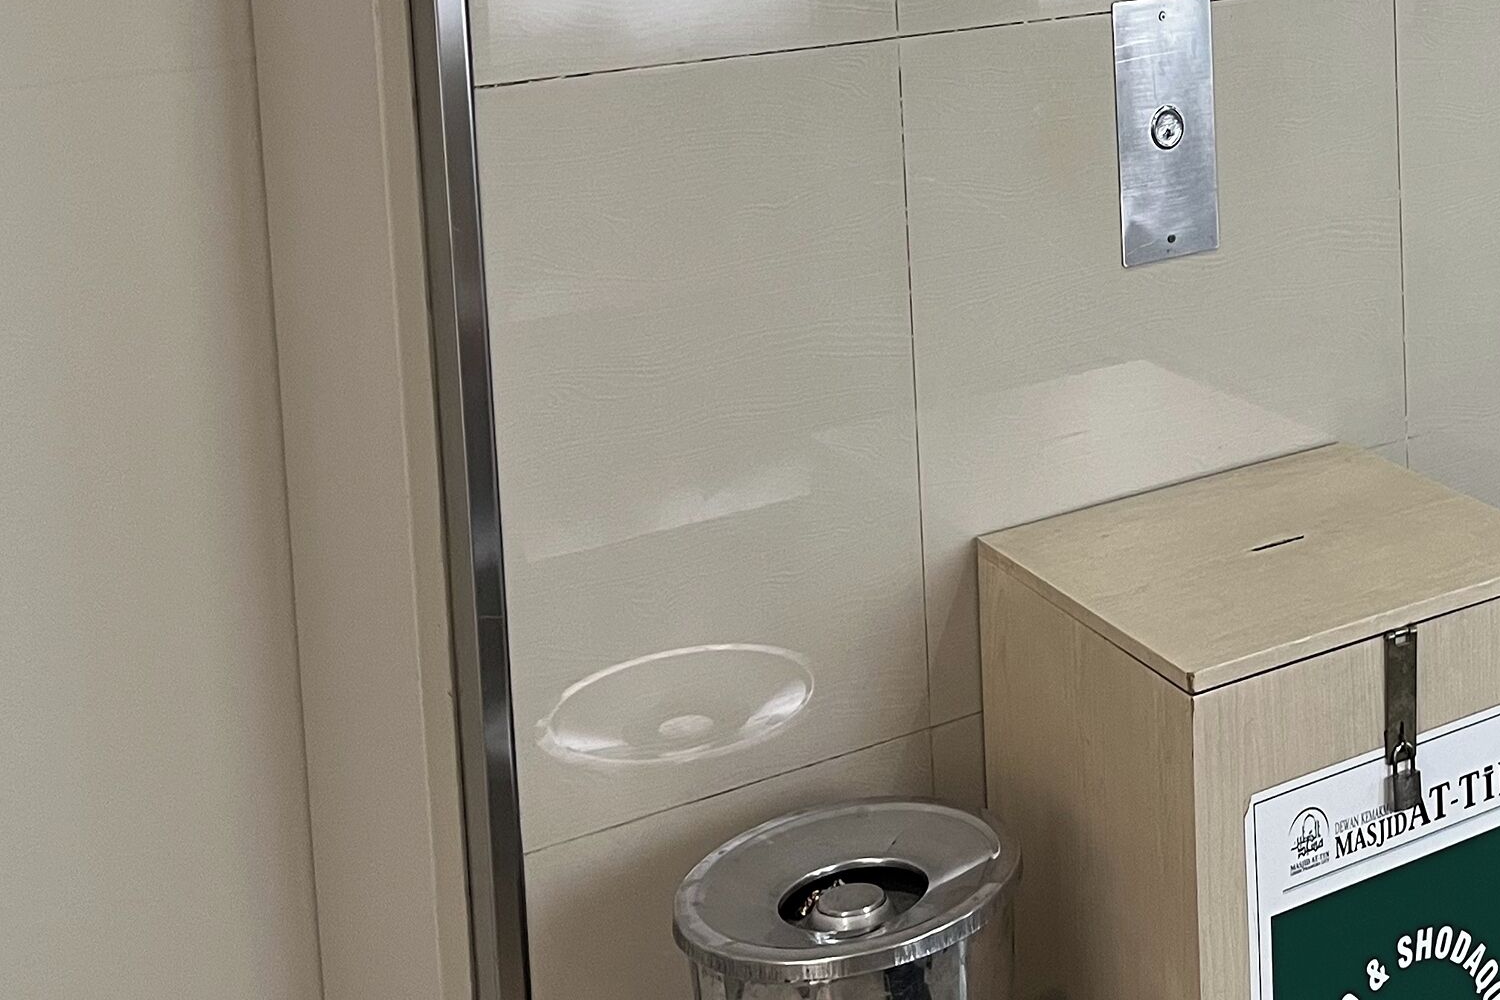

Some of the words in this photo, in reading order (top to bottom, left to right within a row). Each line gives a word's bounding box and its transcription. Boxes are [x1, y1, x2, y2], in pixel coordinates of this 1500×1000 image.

[1334, 814, 1360, 835] DEWAN
[1334, 811, 1408, 859] MASJID
[1366, 958, 1390, 991] &
